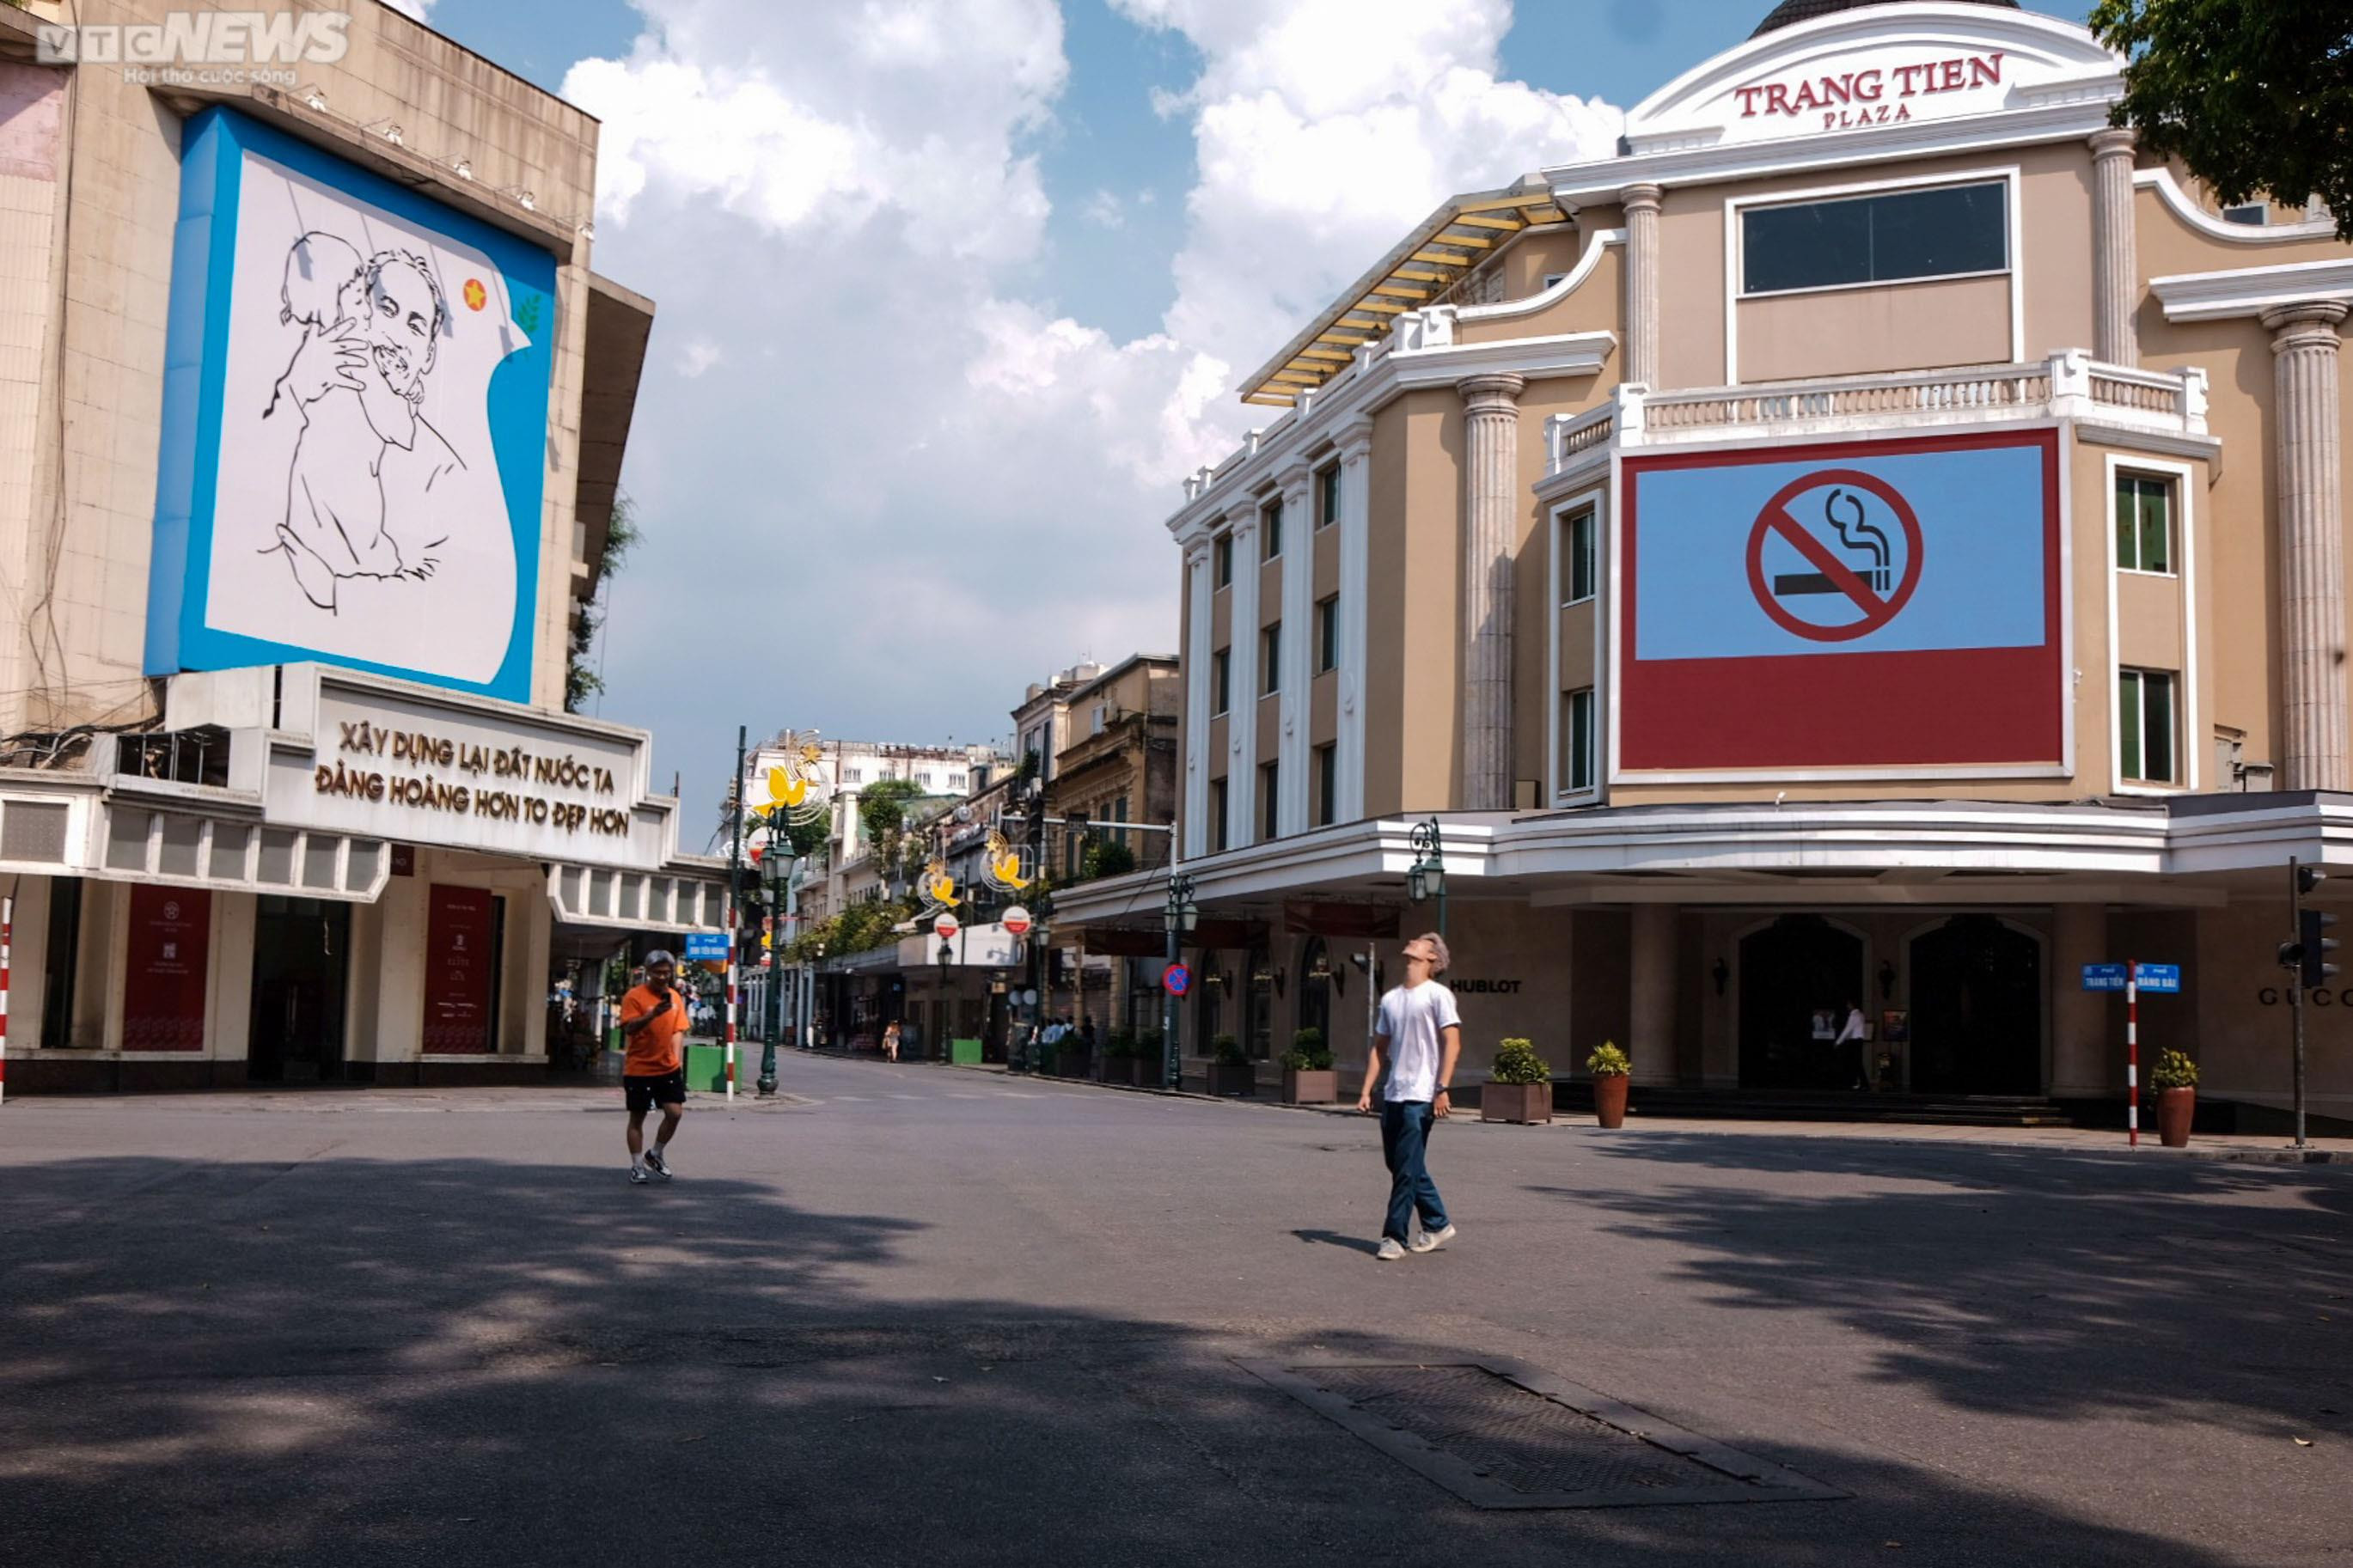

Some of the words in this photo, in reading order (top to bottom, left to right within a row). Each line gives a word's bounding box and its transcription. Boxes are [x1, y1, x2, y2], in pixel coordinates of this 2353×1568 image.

[1734, 69, 1882, 119] TRANG
[1892, 53, 2003, 99] TIEN
[1824, 103, 1911, 130] PLAZA
[340, 720, 388, 757] XÂY
[460, 742, 489, 777] LẠI
[494, 744, 532, 780] ĐẤT
[593, 766, 615, 796] TA
[315, 758, 384, 802] ĐÀNG
[389, 773, 470, 814] HOÀNG
[474, 789, 520, 823] HƠN
[524, 796, 548, 826] TO
[553, 800, 587, 834] ĐẸP
[589, 806, 630, 838] HƠN
[1450, 979, 1522, 993] HUBLOT
